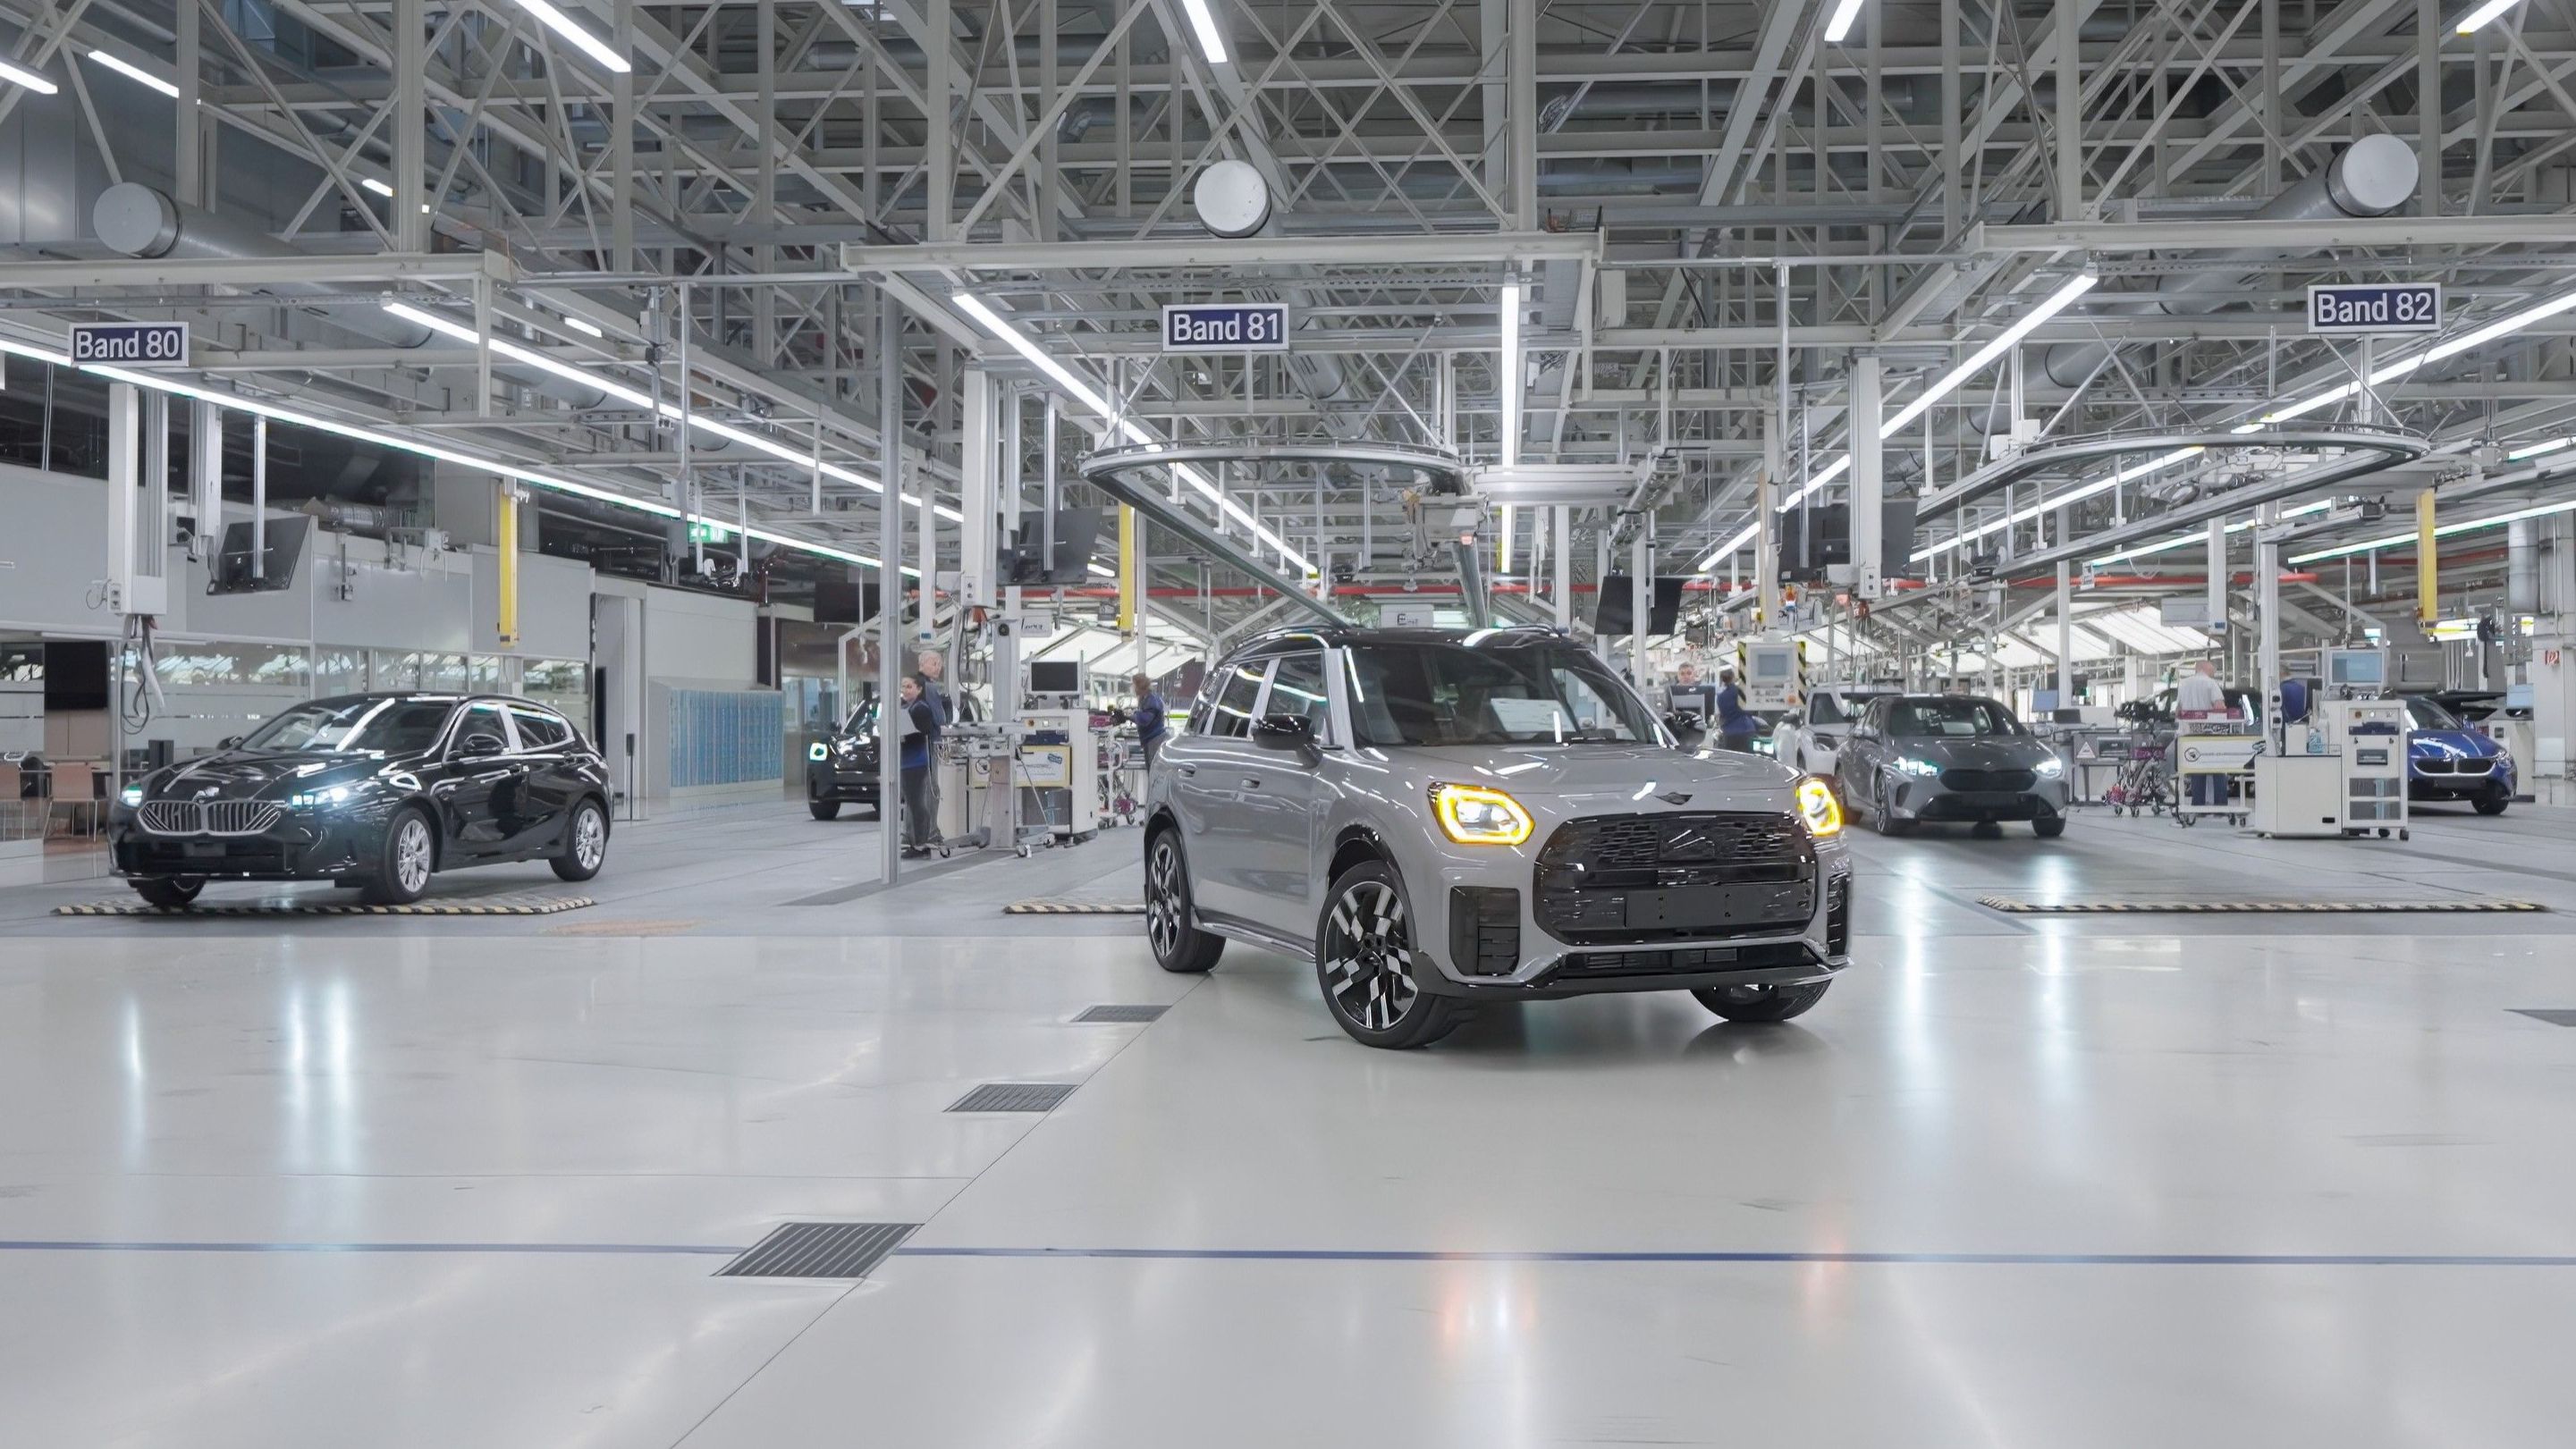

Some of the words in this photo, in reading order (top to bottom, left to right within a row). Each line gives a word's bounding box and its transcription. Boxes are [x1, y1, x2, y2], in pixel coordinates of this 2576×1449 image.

[2318, 292, 2388, 323] Band
[2395, 292, 2432, 322] 82
[1174, 313, 1240, 341] Band
[1246, 313, 1278, 341] 81
[76, 330, 139, 358] Band
[146, 330, 179, 358] 80
